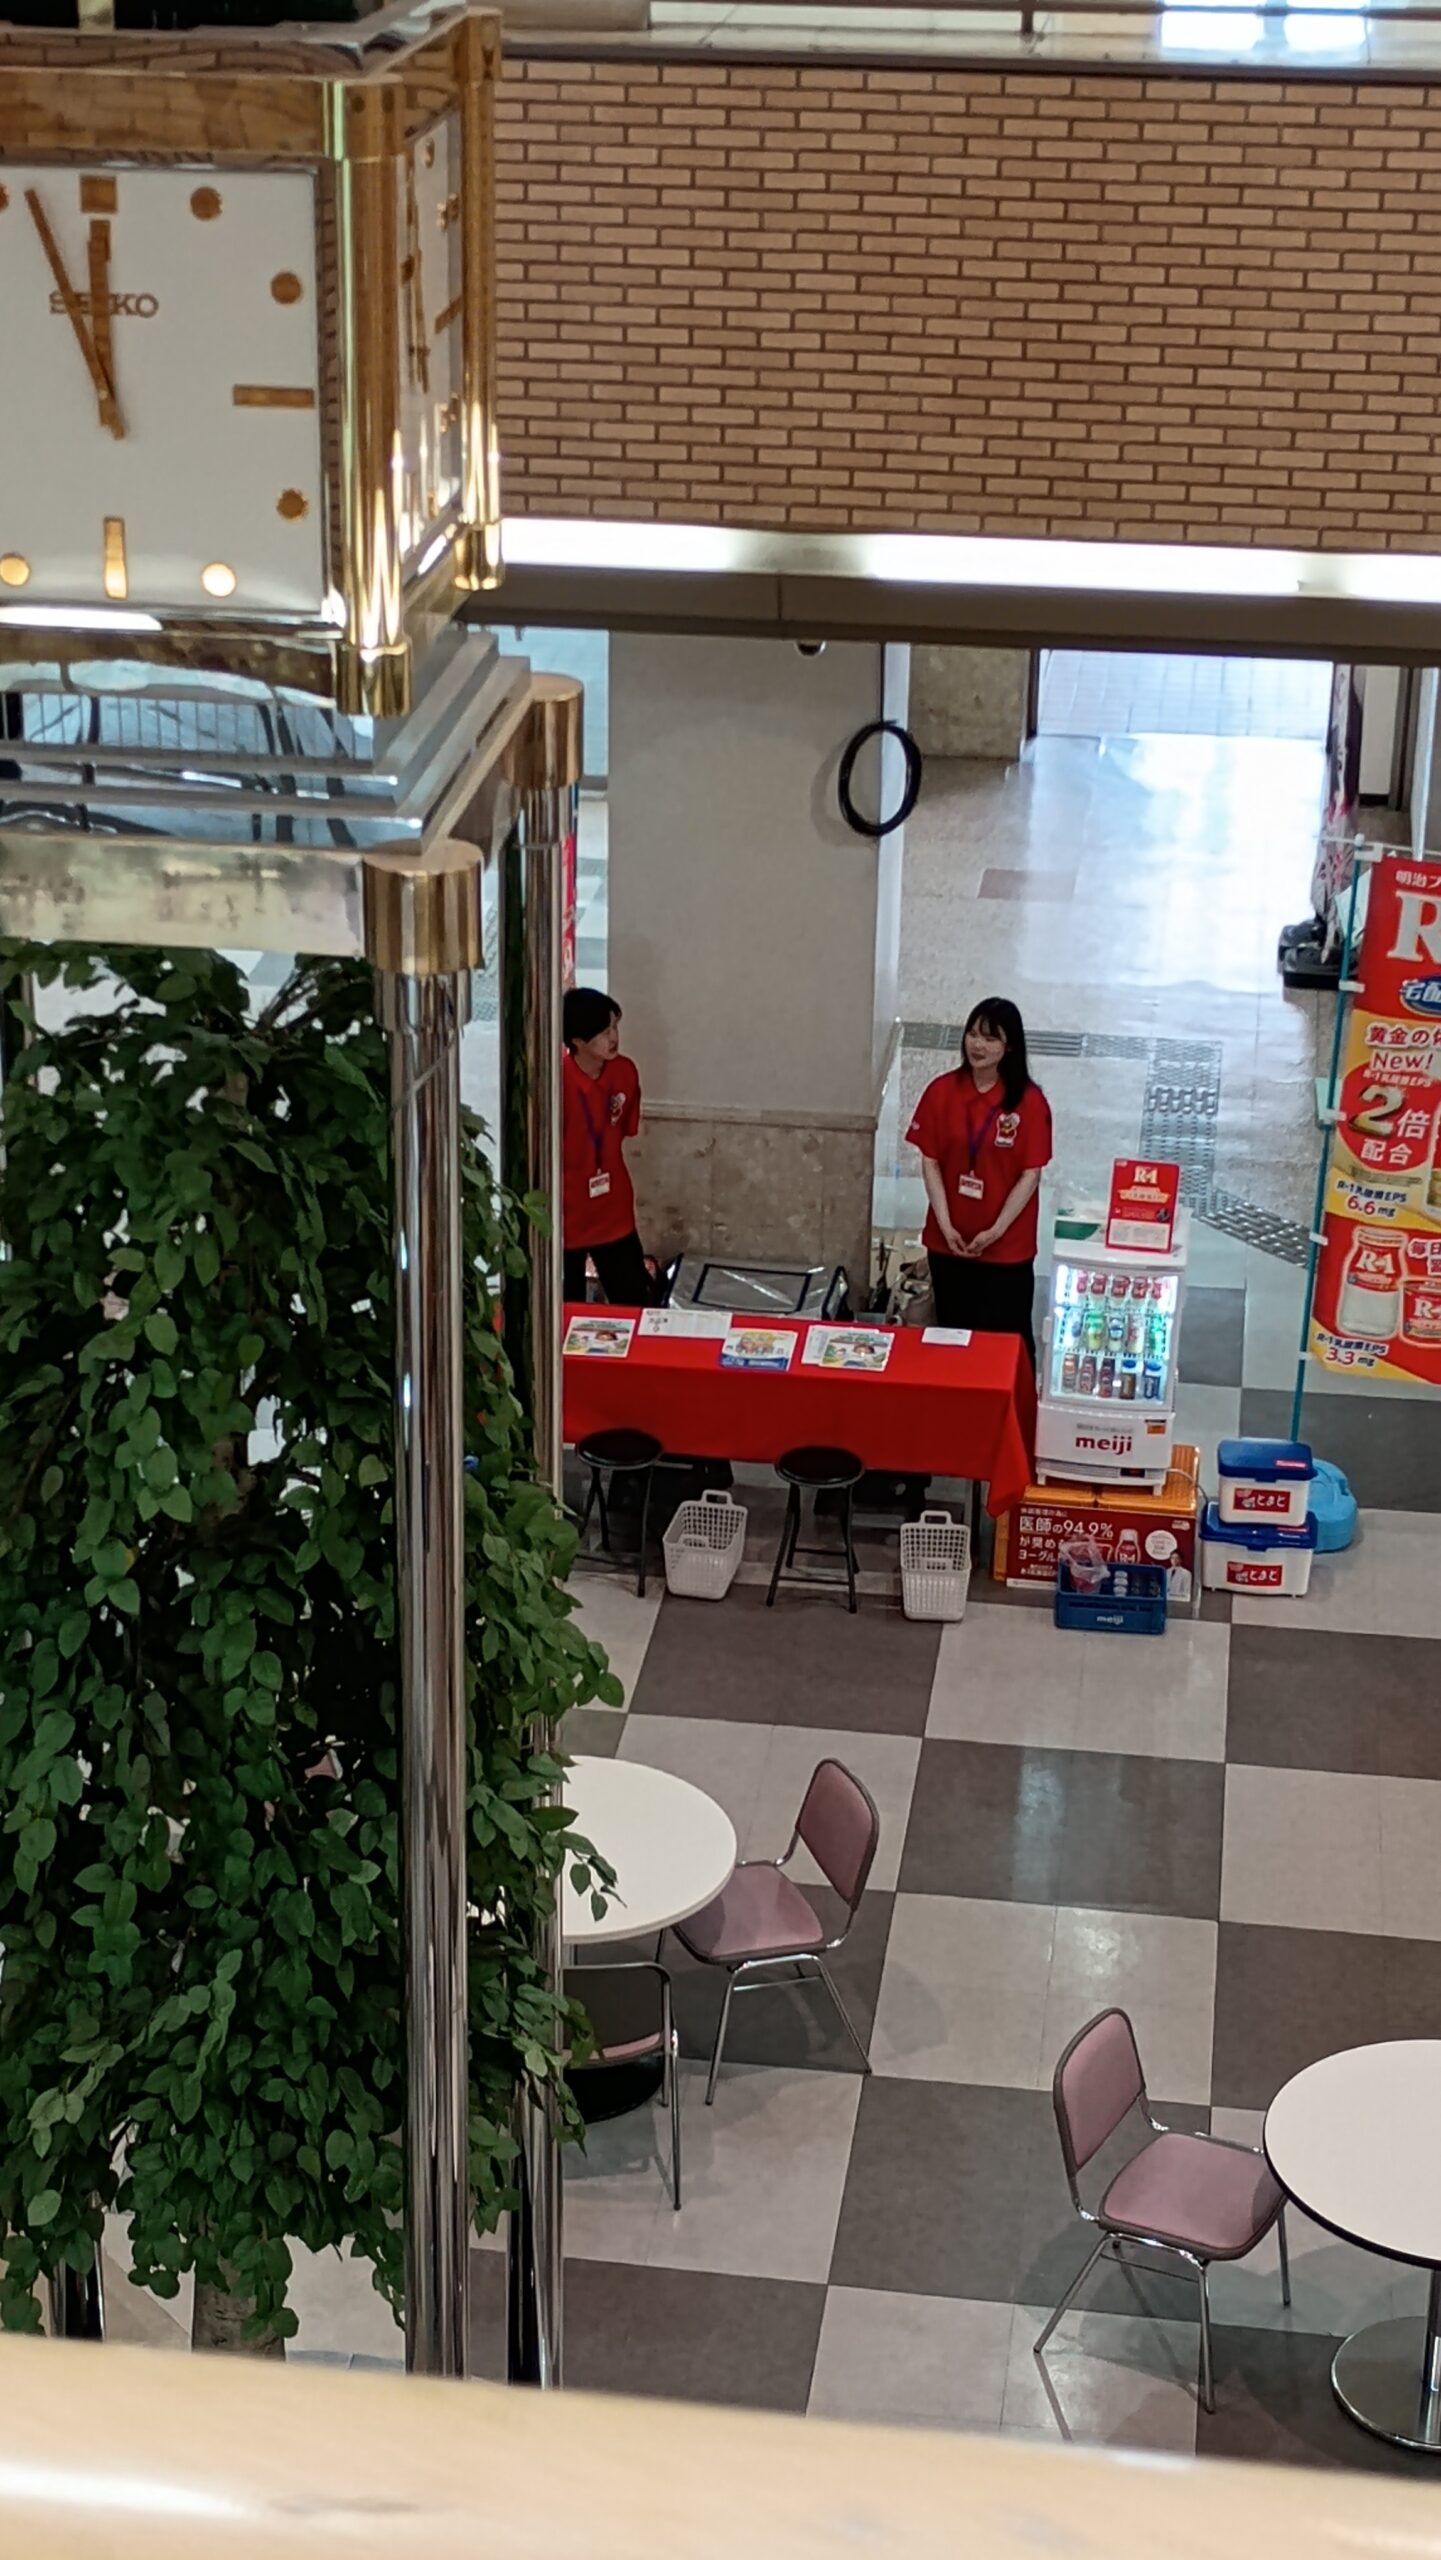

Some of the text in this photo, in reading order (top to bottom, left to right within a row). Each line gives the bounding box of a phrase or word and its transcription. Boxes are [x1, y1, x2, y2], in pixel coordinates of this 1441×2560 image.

[49, 290, 159, 318] SEKO
[1373, 1052, 1433, 1070] New!
[1361, 1138, 1413, 1165] 配合
[1355, 1250, 1395, 1274] R-1
[1075, 1435, 1132, 1456] meiji
[1019, 1536, 1064, 1549] が奨め
[1096, 1614, 1124, 1626] meiji
